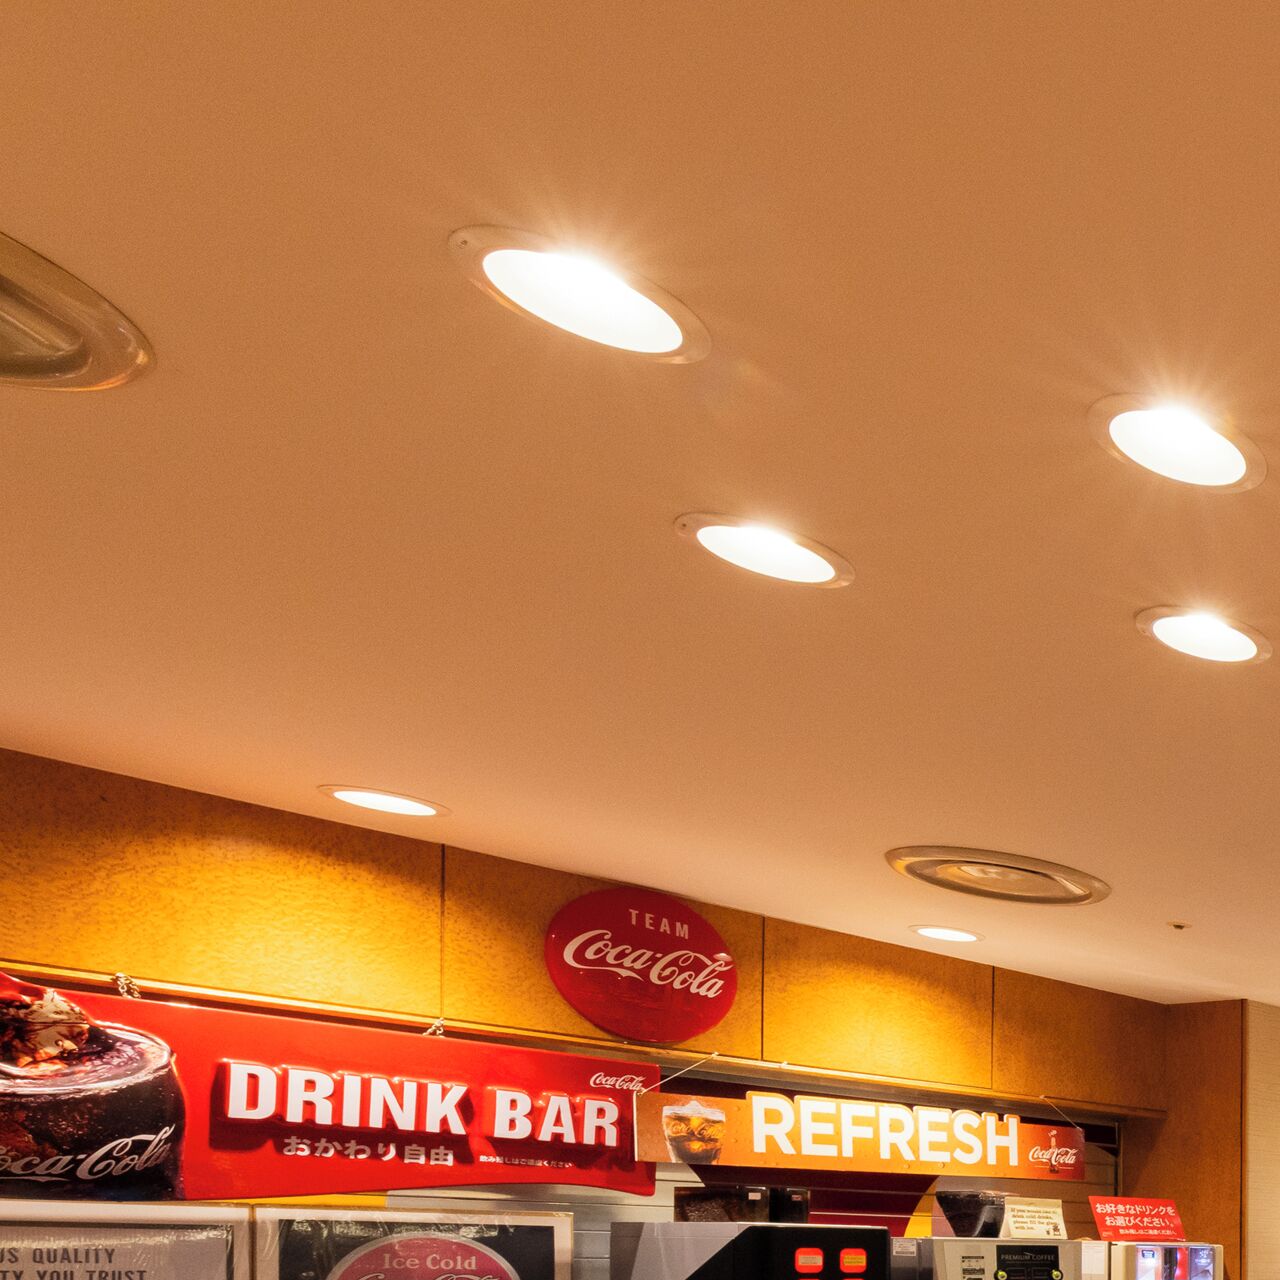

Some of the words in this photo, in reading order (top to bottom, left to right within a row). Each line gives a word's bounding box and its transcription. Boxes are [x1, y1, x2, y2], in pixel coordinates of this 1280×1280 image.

[628, 908, 689, 940] TEAM
[563, 929, 734, 998] Coca-Cola
[589, 1071, 647, 1091] Coca-Cola
[227, 1063, 468, 1135] DRINK
[493, 1089, 619, 1147] BAR
[752, 1095, 1019, 1166] REFRESH
[282, 1135, 454, 1167] おかわり自由
[1028, 1145, 1079, 1166] Coca-Cola
[32, 1247, 116, 1264] QUALITY
[383, 1254, 420, 1270] Ice
[426, 1254, 478, 1271] Cold
